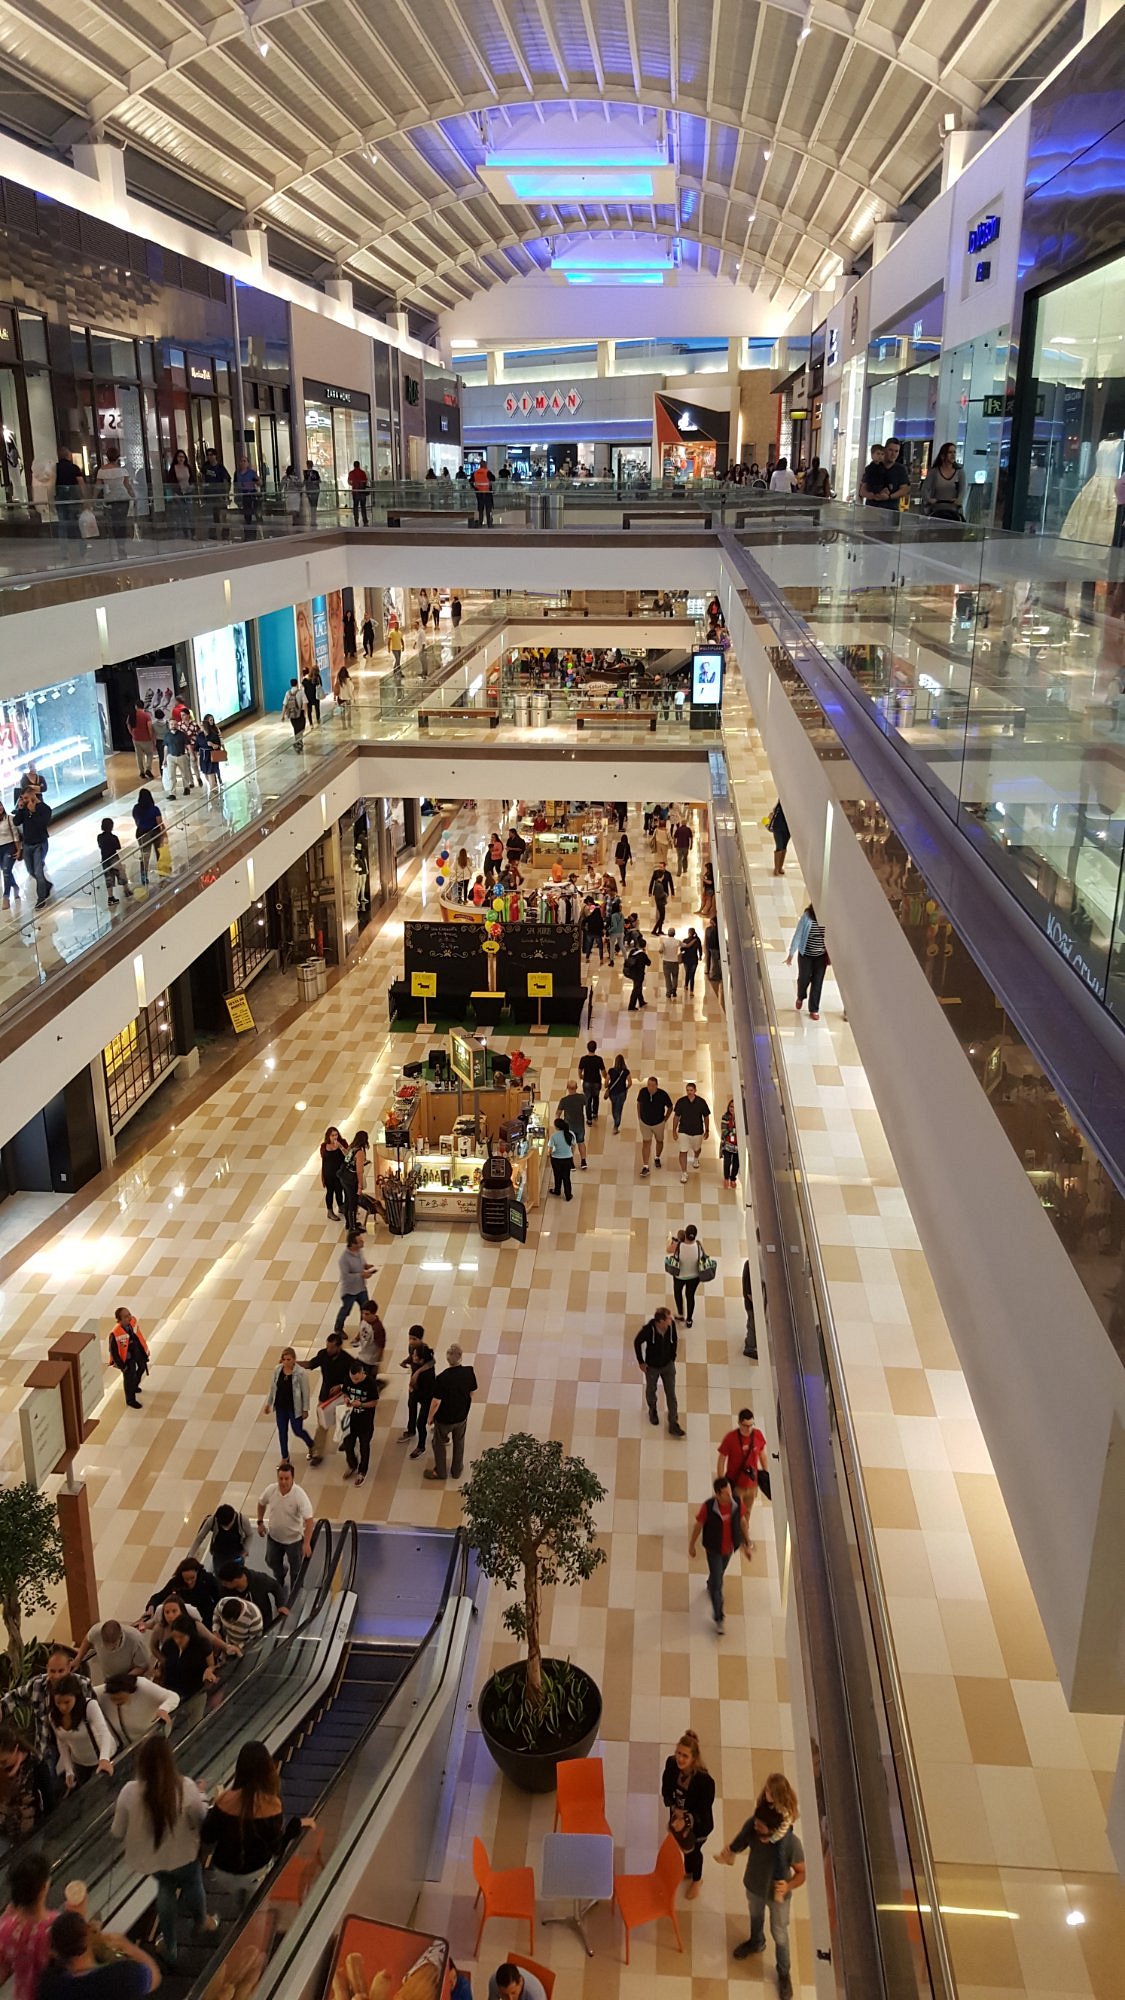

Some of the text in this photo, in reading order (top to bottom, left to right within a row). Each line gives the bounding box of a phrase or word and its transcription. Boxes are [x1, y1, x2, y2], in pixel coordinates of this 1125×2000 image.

[326, 388, 351, 403] ZARA HOME
[506, 394, 577, 411] SIMAN
